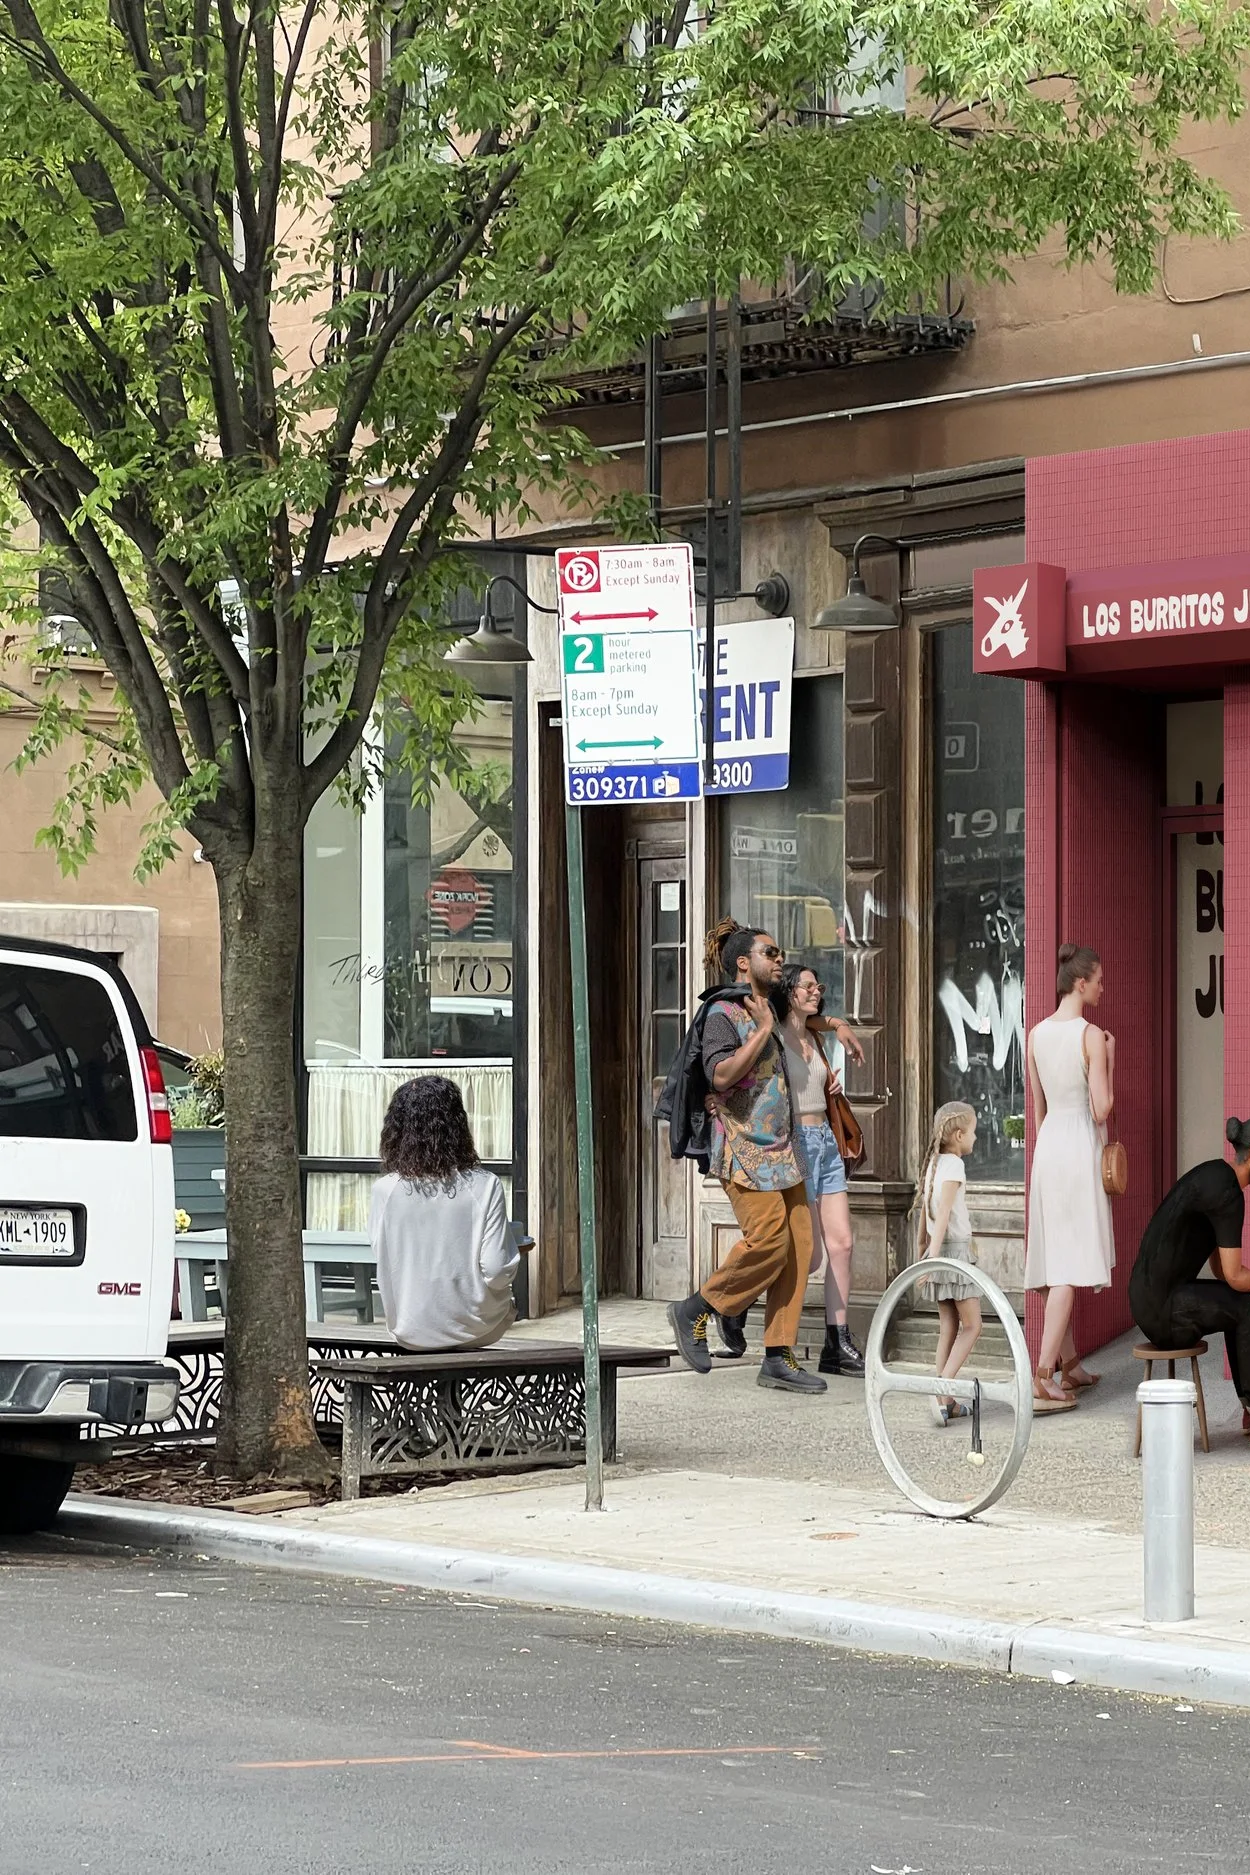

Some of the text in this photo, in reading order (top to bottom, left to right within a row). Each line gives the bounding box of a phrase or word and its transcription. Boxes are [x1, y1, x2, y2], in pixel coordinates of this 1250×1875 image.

[605, 559, 643, 570] 7:30am
[652, 557, 675, 568] 8am
[606, 573, 680, 587] Except Sunday
[1083, 601, 1121, 638] LOS
[1130, 591, 1225, 634] BURRITOS
[609, 637, 631, 647] hour
[573, 636, 595, 671] 2
[609, 649, 651, 660] metered
[610, 662, 647, 675] parking
[571, 688, 597, 701] 8am
[609, 687, 634, 702] 7pm
[571, 702, 659, 718] Except Sunday
[572, 776, 648, 800] 309371
[10, 1211, 51, 1221] NEW YORK
[33, 1221, 66, 1243] 1909
[98, 1282, 142, 1295] GMC
